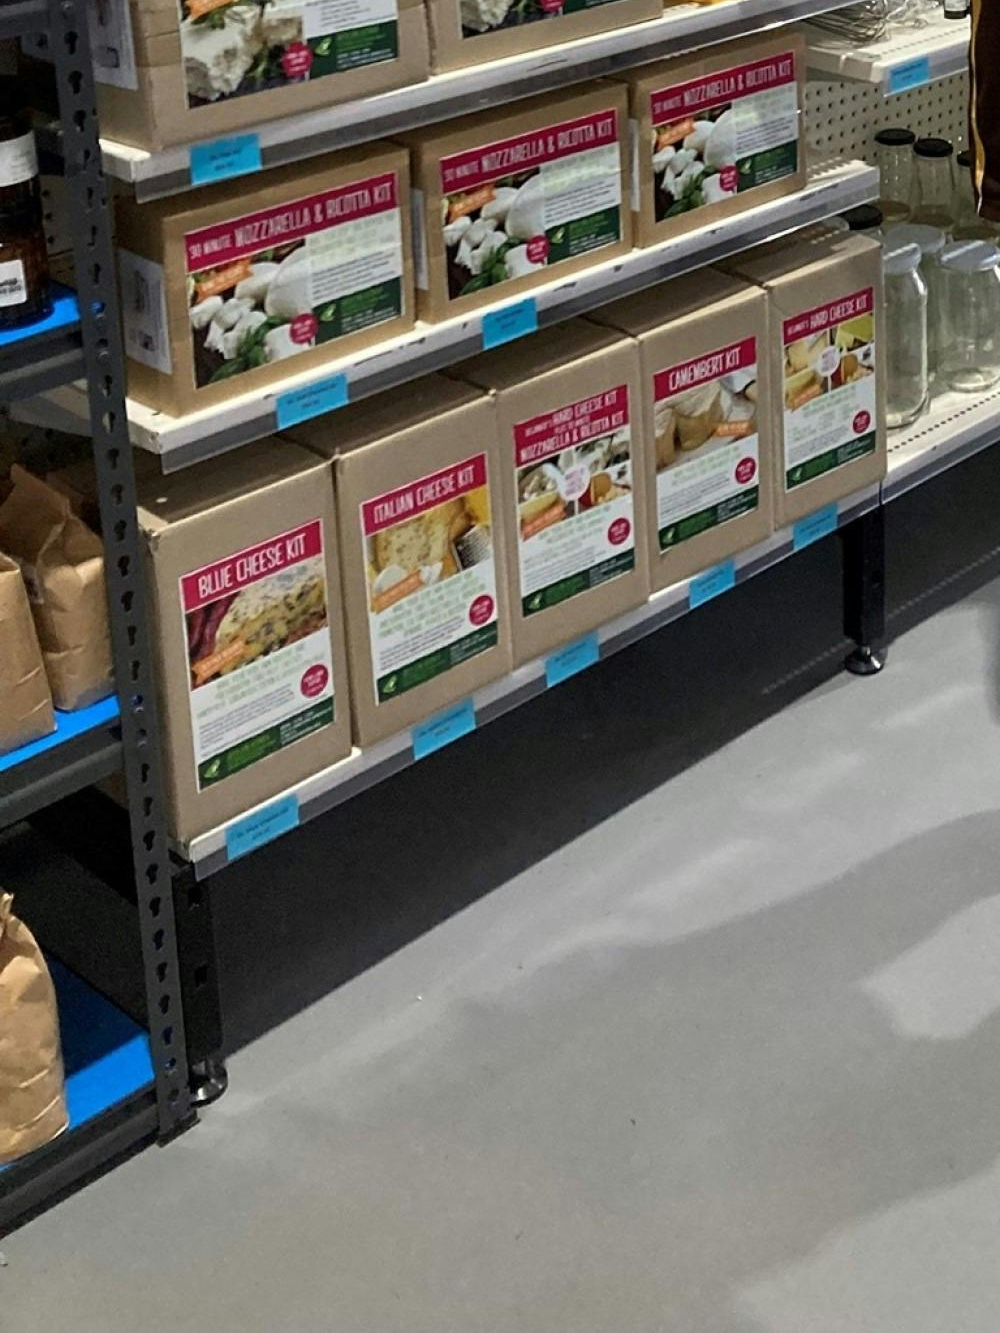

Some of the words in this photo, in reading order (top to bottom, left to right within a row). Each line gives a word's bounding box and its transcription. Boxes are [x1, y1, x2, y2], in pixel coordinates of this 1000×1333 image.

[778, 59, 792, 78] KIT
[481, 139, 545, 173] MOZZARELLA
[546, 135, 556, 153] &
[597, 118, 613, 138] KIT
[234, 207, 311, 248] MOZZARELLA
[313, 203, 324, 224] &
[373, 181, 393, 204] KIT
[829, 298, 855, 322] CHEESE
[856, 294, 867, 311] KIT
[669, 353, 725, 392] CAMEMBERT
[725, 347, 742, 369] KIT
[605, 389, 618, 406] KIT
[611, 410, 624, 427] KIT
[373, 492, 414, 524] ITALIAN
[416, 473, 456, 507] CHEESE
[458, 464, 475, 486] KIT
[197, 570, 233, 599] BLUE
[236, 543, 284, 582] CHEESE
[286, 532, 306, 559] KIT
